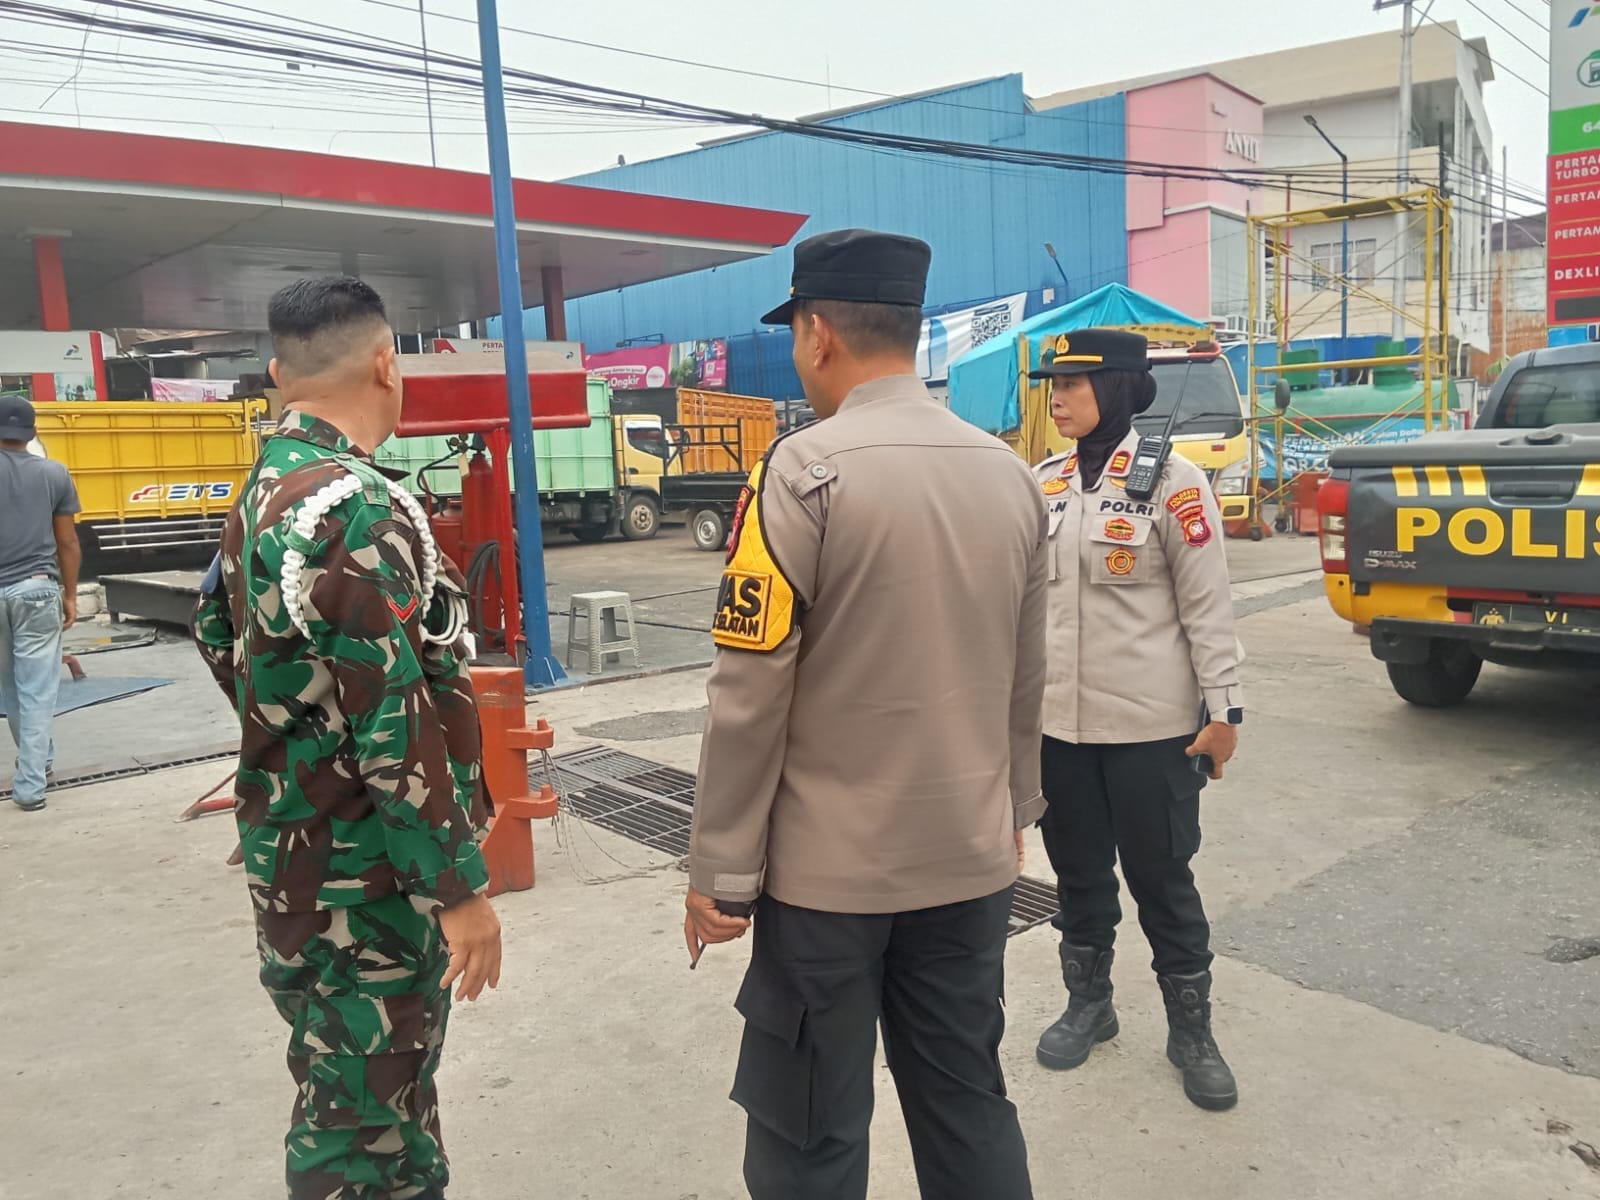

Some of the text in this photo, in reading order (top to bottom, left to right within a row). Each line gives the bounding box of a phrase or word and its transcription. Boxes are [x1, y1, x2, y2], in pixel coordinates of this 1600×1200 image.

[1555, 154, 1600, 170] PERTA
[1555, 166, 1599, 180] TURBO
[1555, 190, 1600, 204] PERTA
[1554, 265, 1600, 281] DEXLI
[1100, 501, 1153, 516] POLRI
[1396, 507, 1600, 559] POLI
[717, 574, 761, 618] AS
